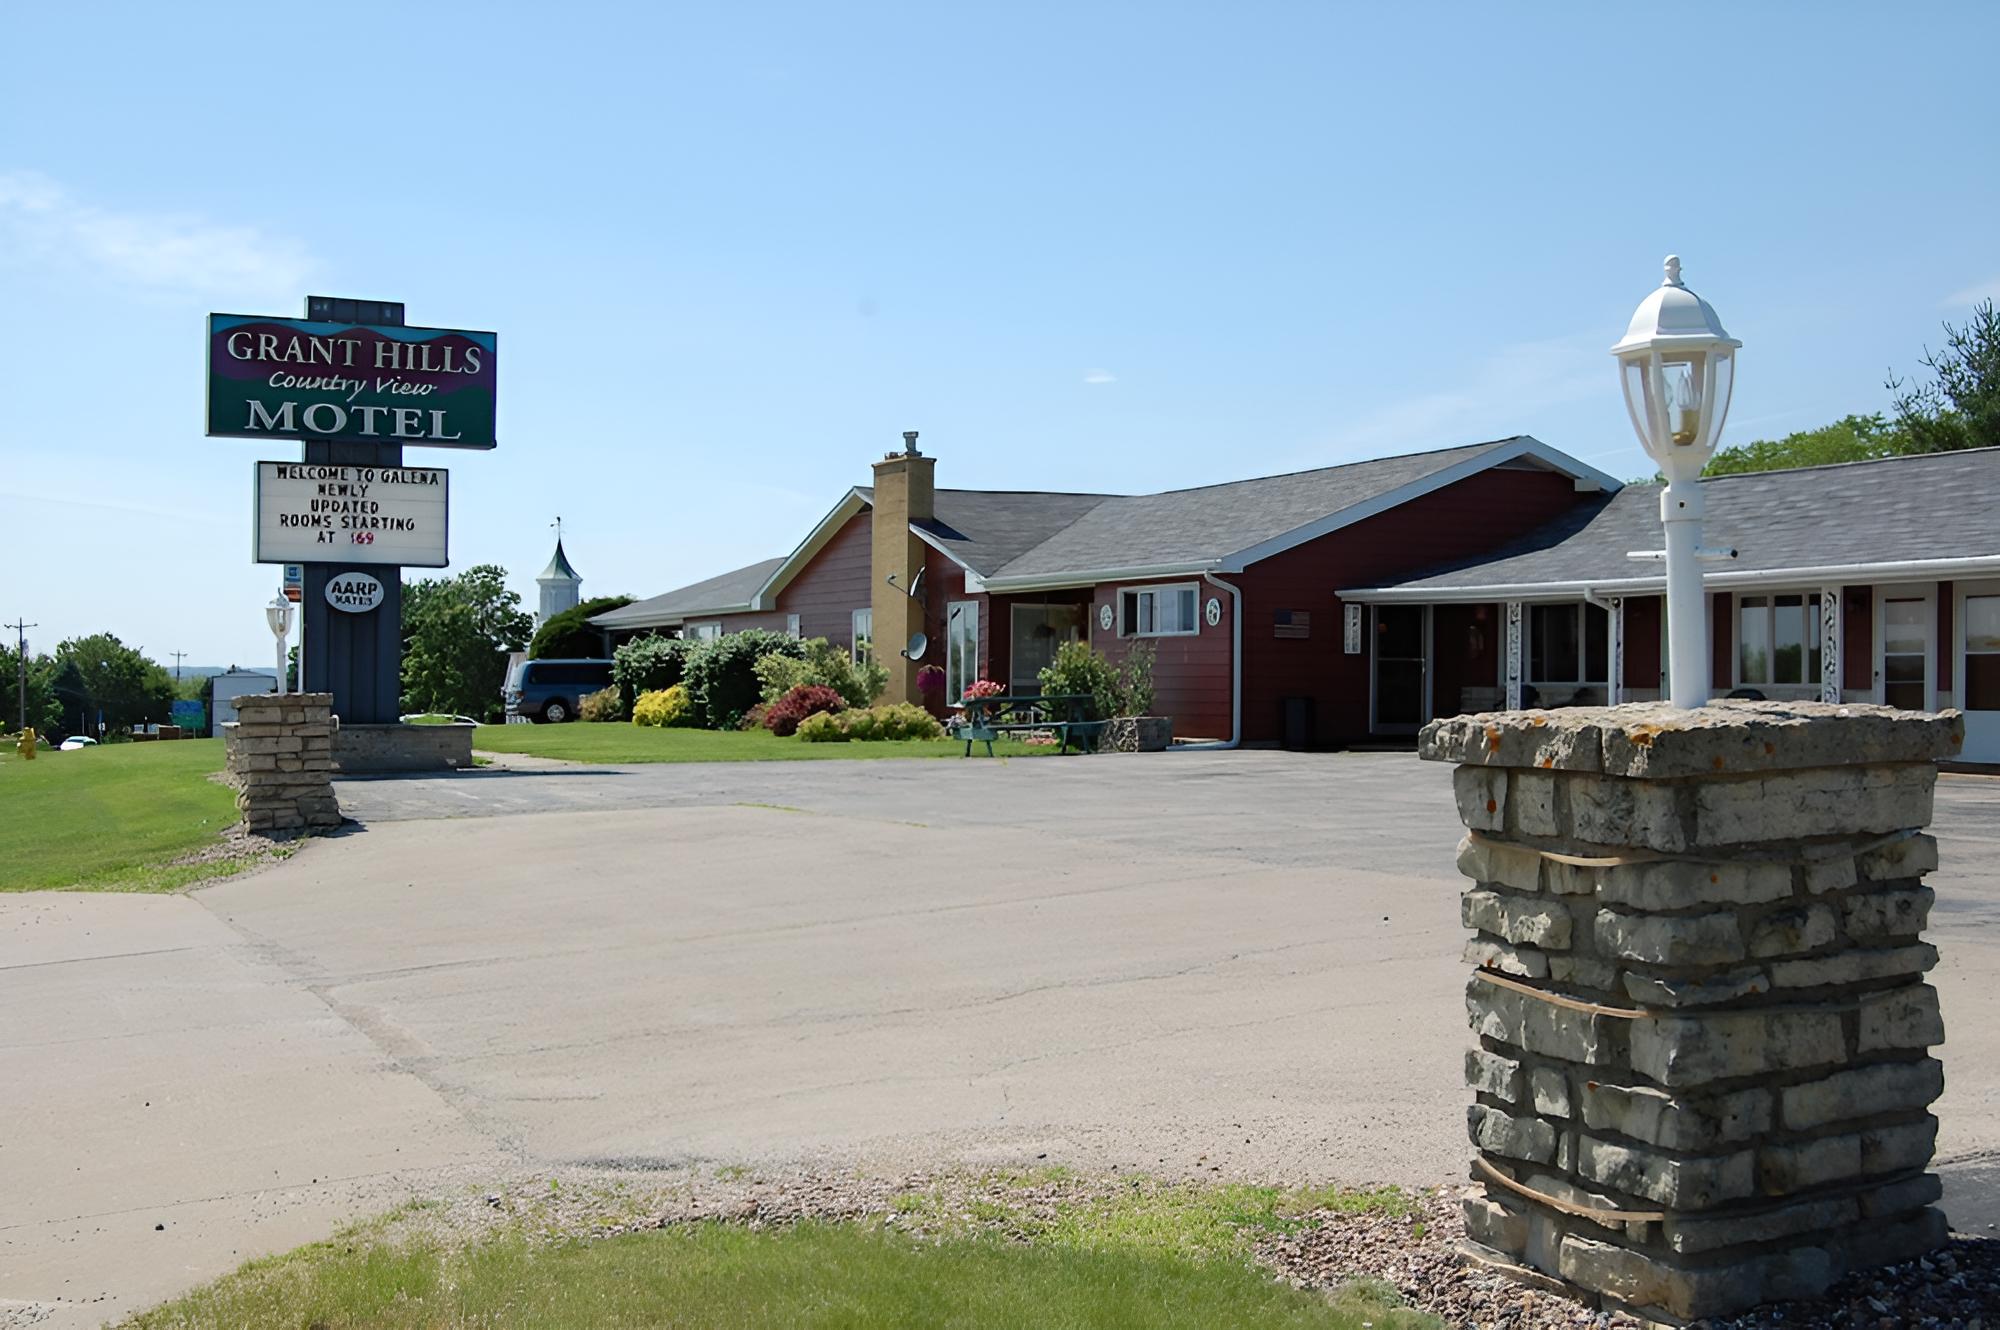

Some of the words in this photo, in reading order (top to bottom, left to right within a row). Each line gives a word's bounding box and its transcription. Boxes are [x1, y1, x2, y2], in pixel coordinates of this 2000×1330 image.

[227, 332, 361, 367] GRANT
[374, 341, 482, 374] HILLS
[269, 371, 367, 401] Country
[376, 377, 438, 395] View
[244, 399, 461, 439] MOTEL
[277, 466, 349, 480] WELCOME
[356, 469, 375, 483] TO
[380, 470, 438, 485] GALENA
[318, 483, 368, 497] NEWLY
[311, 499, 379, 514] UPDATED
[280, 514, 332, 528] ROOMS
[341, 515, 415, 531] STARTING
[317, 531, 336, 543] AT
[331, 581, 377, 595] AARP
